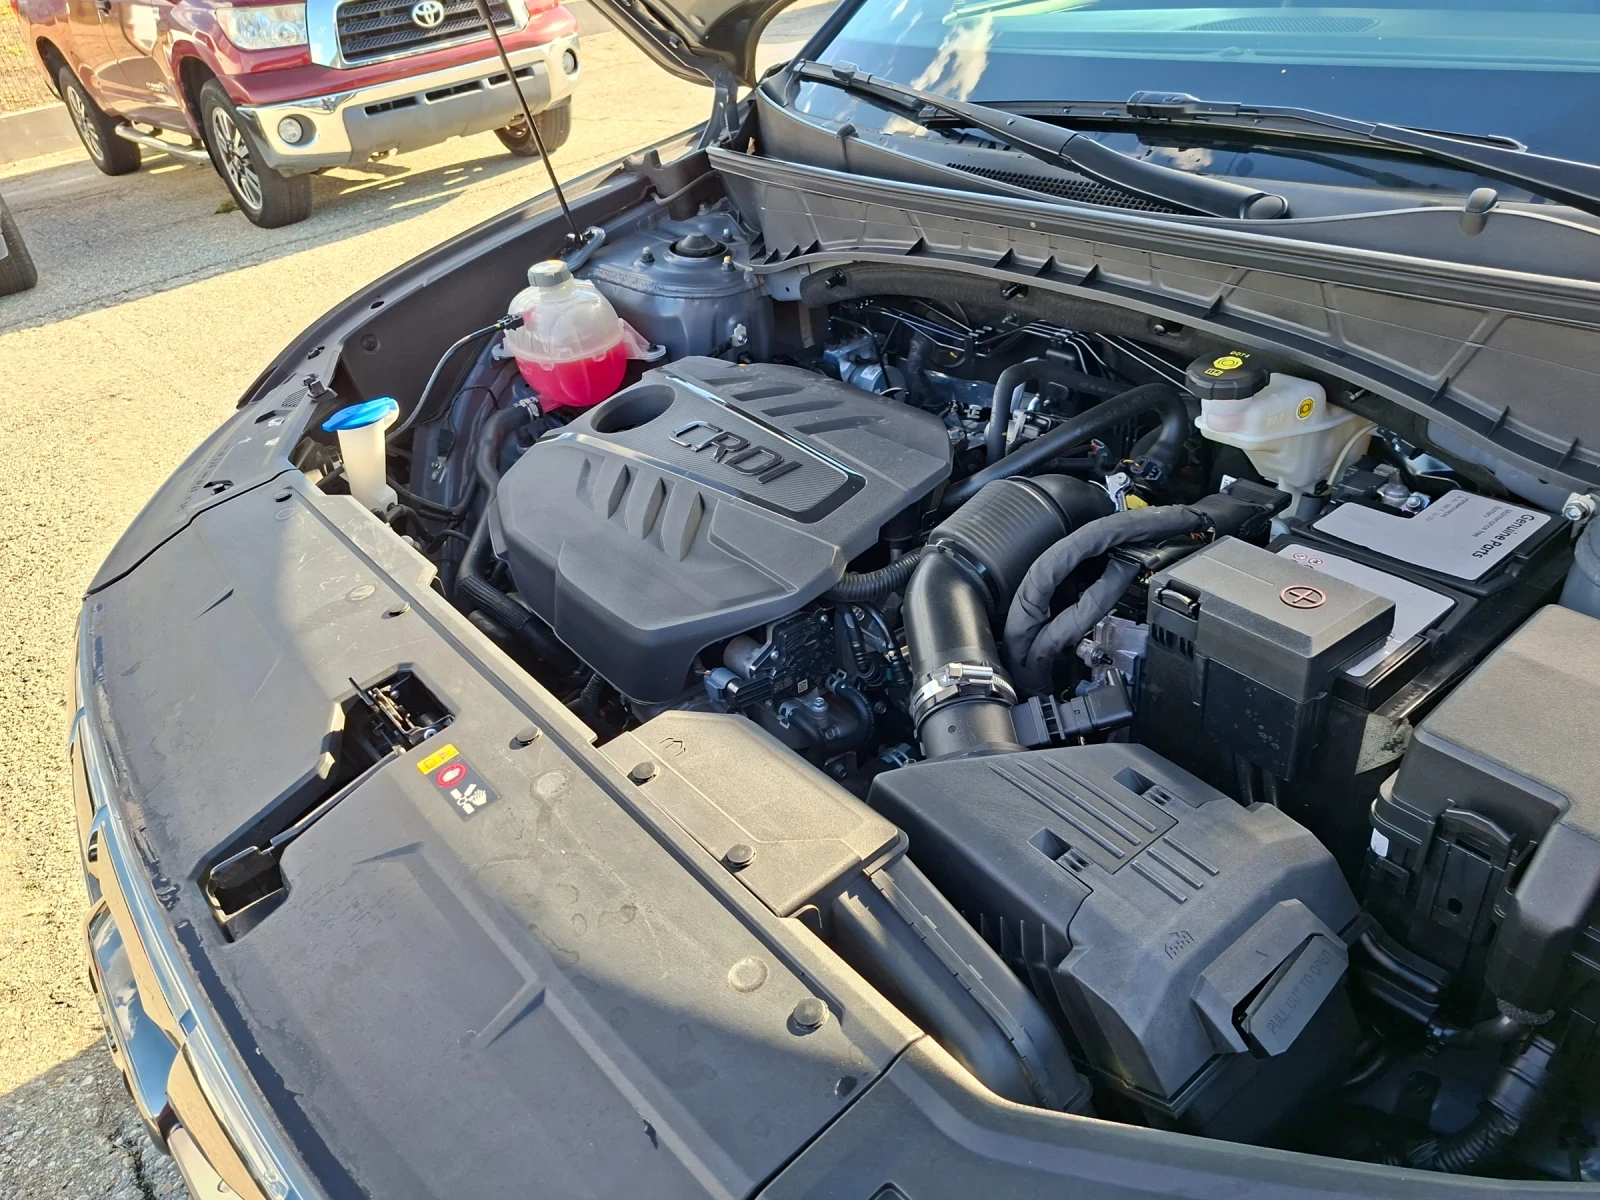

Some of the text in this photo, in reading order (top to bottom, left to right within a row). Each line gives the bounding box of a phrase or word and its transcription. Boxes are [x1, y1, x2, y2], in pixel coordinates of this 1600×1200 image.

[668, 420, 803, 484] CRDI
[1472, 514, 1535, 558] Genuine Parts
[1267, 949, 1334, 1034] PULL OUT TO OPEN
